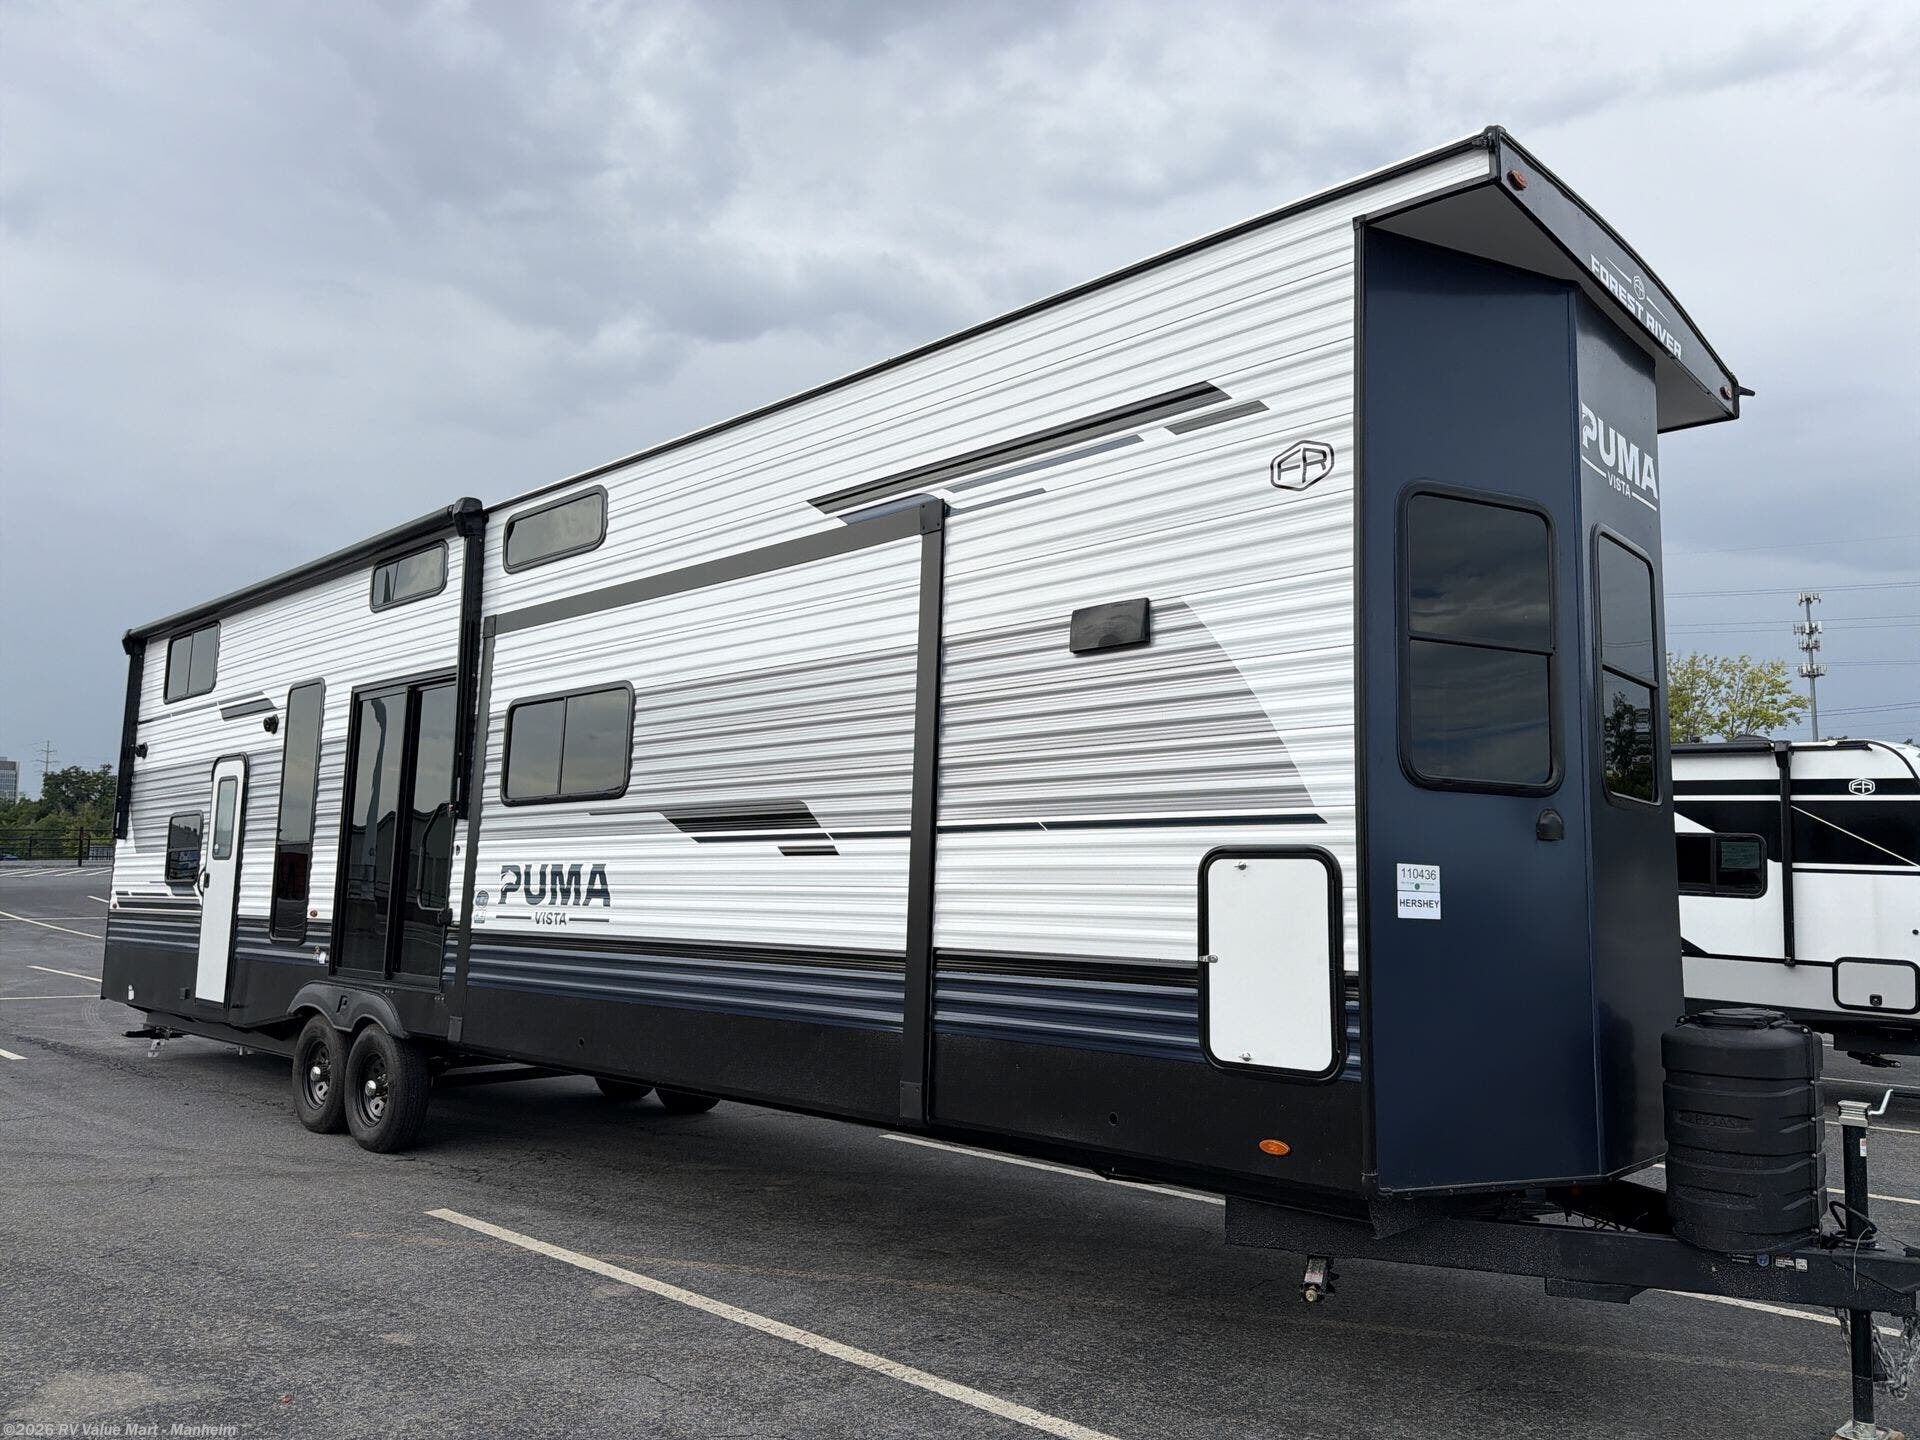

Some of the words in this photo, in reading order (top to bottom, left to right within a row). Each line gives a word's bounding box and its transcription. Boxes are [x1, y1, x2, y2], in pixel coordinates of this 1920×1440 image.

[1590, 253, 1644, 320] FOREST
[1646, 310, 1682, 360] RIVER
[1581, 400, 1658, 500] PUMA
[1607, 470, 1632, 499] VISTA
[498, 863, 611, 907] PUMA
[1401, 867, 1437, 881] 110436
[1400, 898, 1440, 909] HERSHEY
[534, 911, 567, 926] VISTA
